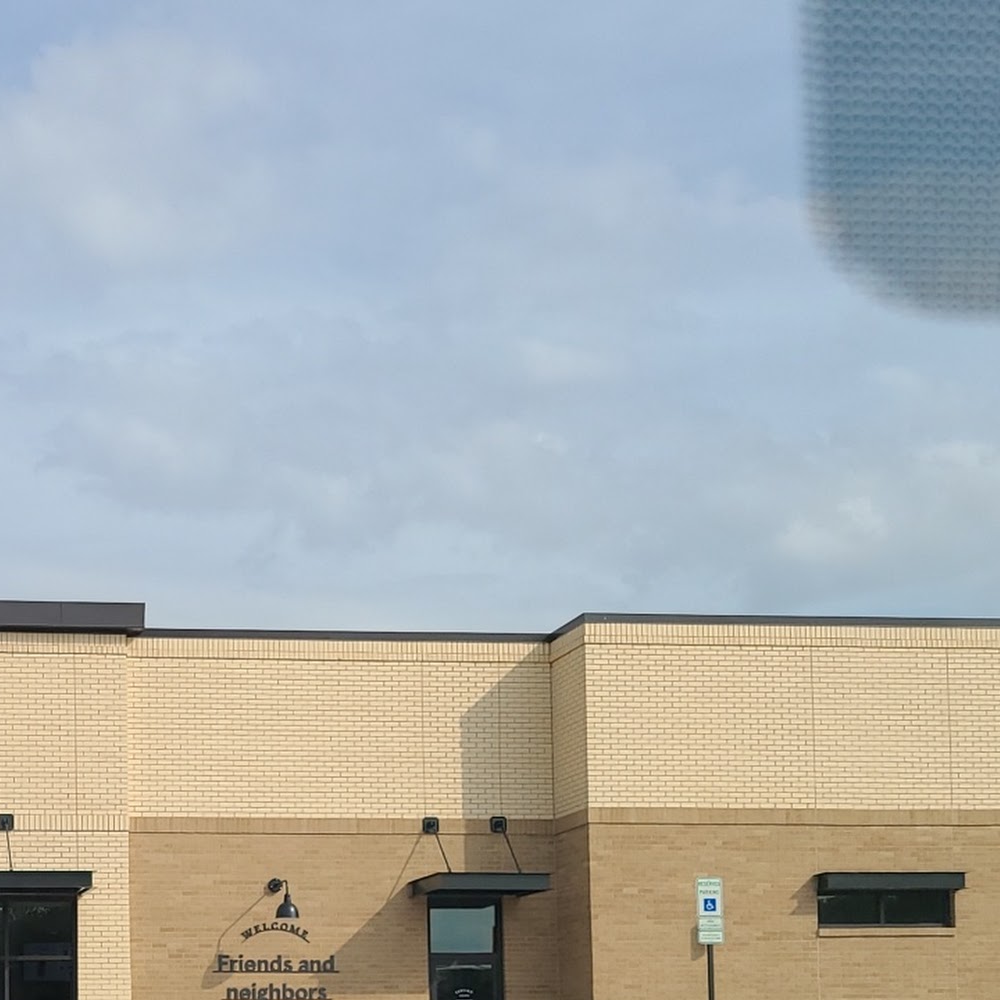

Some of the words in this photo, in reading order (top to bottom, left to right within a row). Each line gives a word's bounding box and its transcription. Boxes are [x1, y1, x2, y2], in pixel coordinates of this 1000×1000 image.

[240, 921, 310, 940] WELCOME
[217, 954, 292, 972] Friends
[299, 954, 335, 972] and
